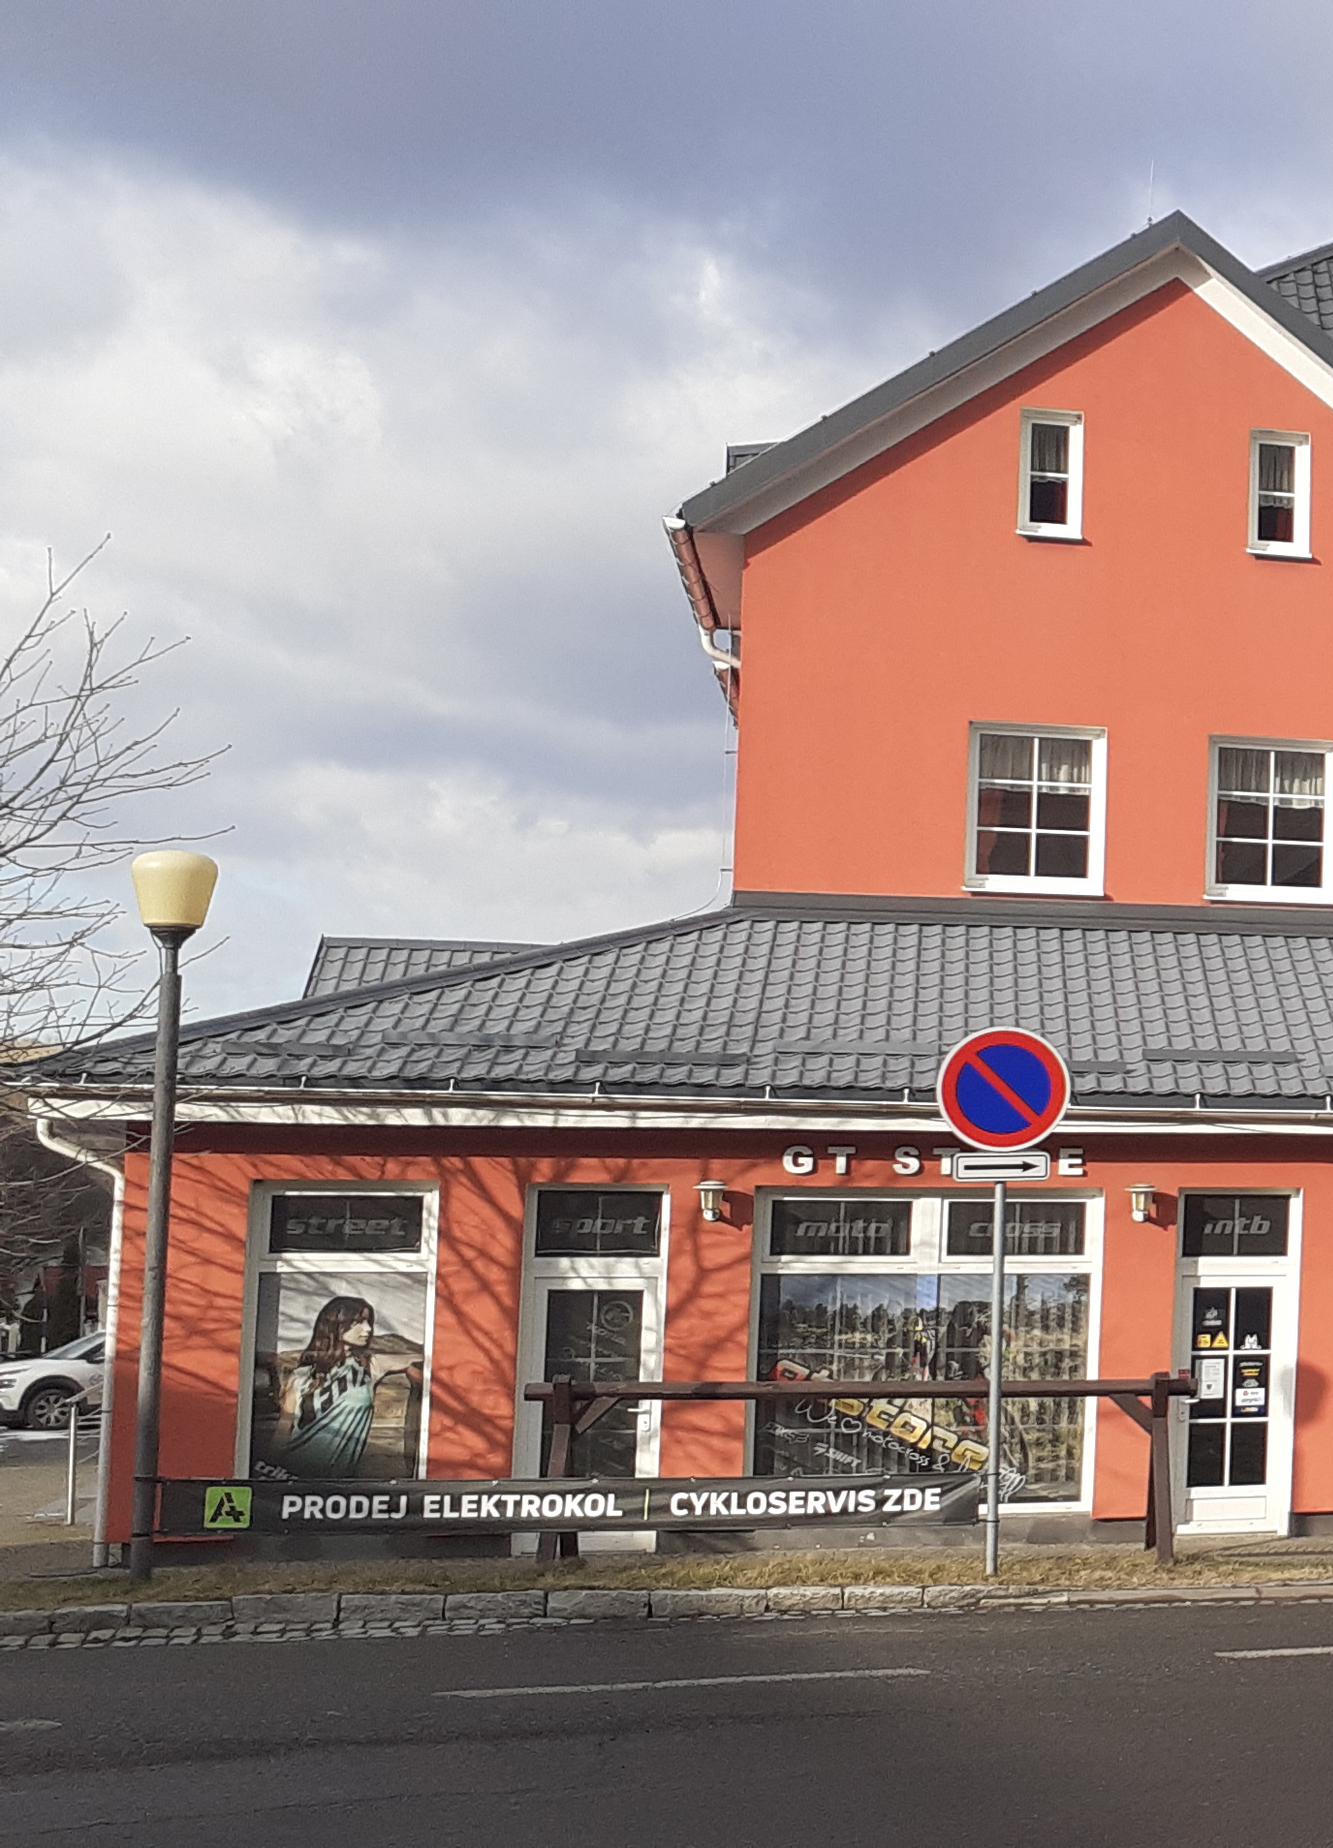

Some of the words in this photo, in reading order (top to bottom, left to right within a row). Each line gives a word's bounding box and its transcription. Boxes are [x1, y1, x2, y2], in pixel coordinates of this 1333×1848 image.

[783, 1145, 856, 1176] GT
[892, 1146, 1084, 1176] STE
[286, 1215, 408, 1236] street
[553, 1216, 651, 1236] sport
[795, 1219, 892, 1237] moto
[281, 1494, 407, 1519] PRODEJ
[423, 1493, 623, 1518] ELEKTROKOL
[670, 1490, 876, 1516] CYKLOSERVIS
[882, 1487, 942, 1512] ZDE
